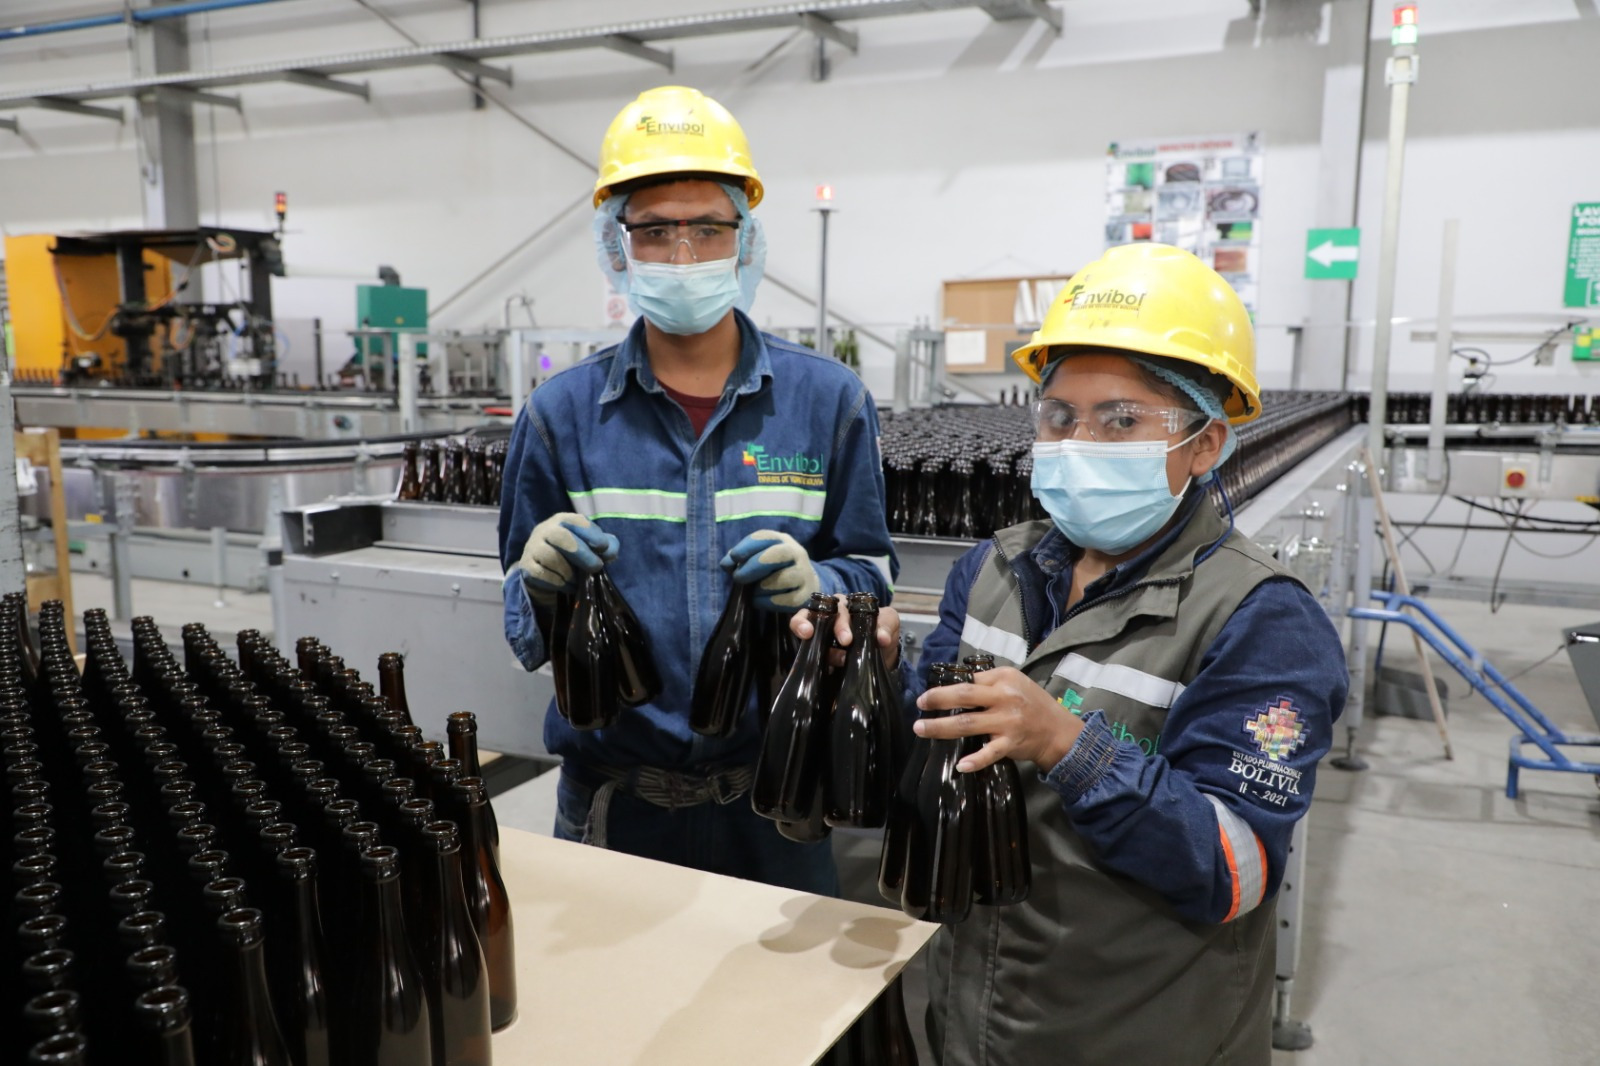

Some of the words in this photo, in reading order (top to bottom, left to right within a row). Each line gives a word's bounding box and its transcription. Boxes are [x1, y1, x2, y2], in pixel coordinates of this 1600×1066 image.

[646, 121, 704, 134] Envibol
[1072, 289, 1146, 307] Envibol
[757, 452, 824, 473] Envibol
[1232, 750, 1257, 765] ESTADO
[1228, 757, 1300, 795] BOLIVIA
[1262, 790, 1288, 807] 2021
